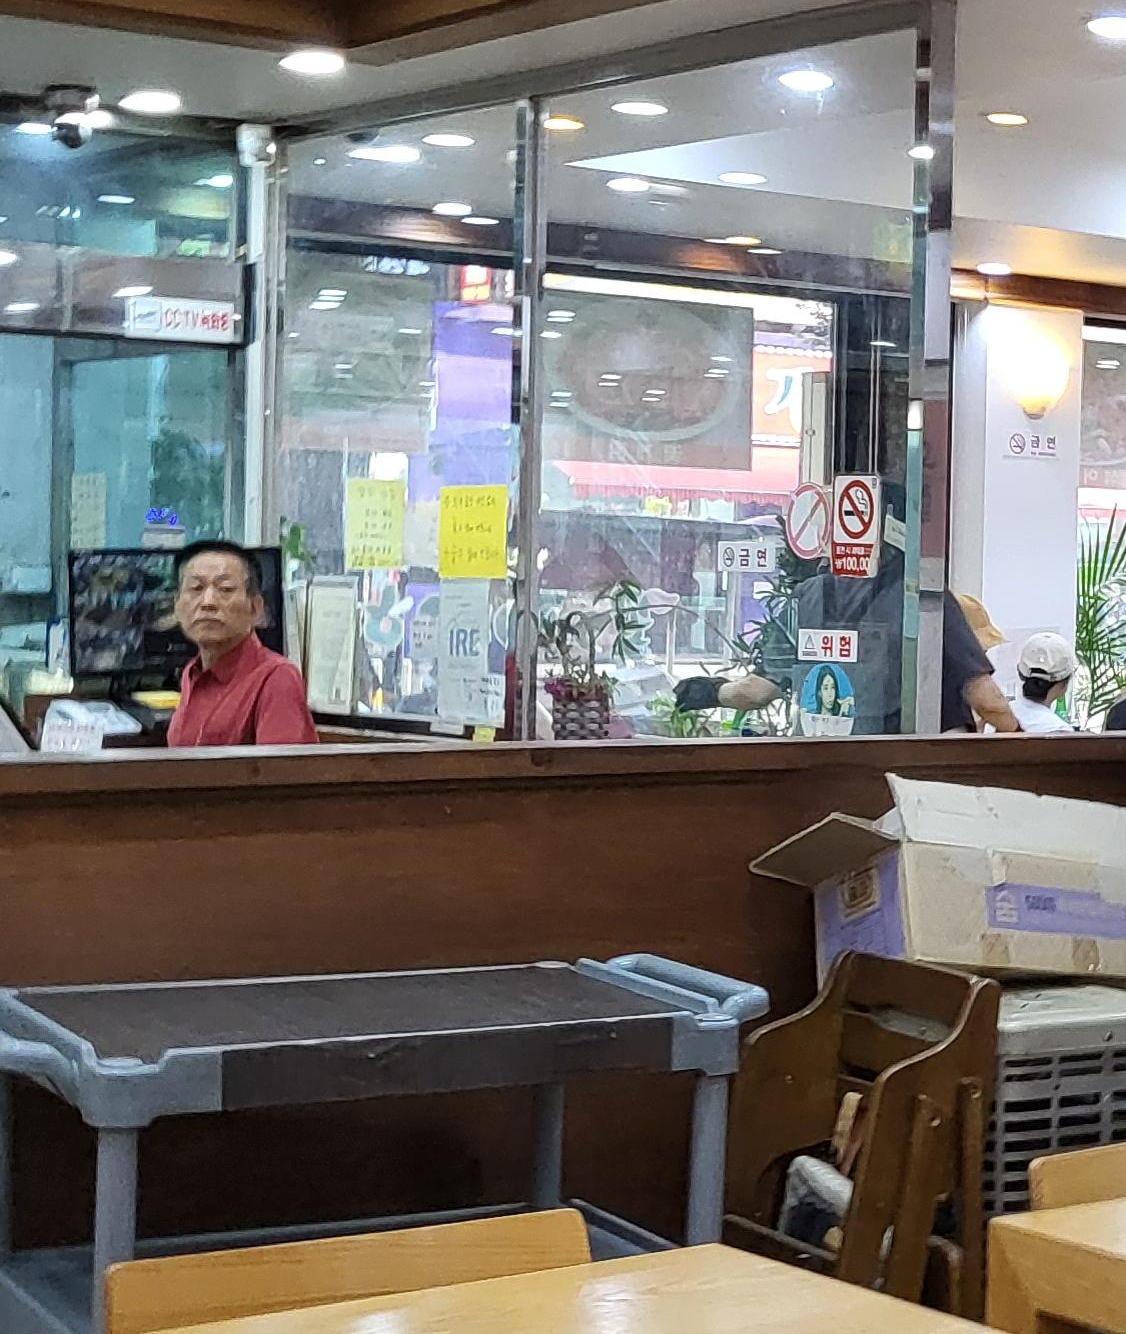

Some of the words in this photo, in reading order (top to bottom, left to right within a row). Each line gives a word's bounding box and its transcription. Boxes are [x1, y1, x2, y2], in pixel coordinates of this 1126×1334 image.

[164, 307, 199, 329] CCTV
[1030, 434, 1056, 450] 금연
[738, 547, 768, 568] 금연
[821, 635, 852, 658] 위험
